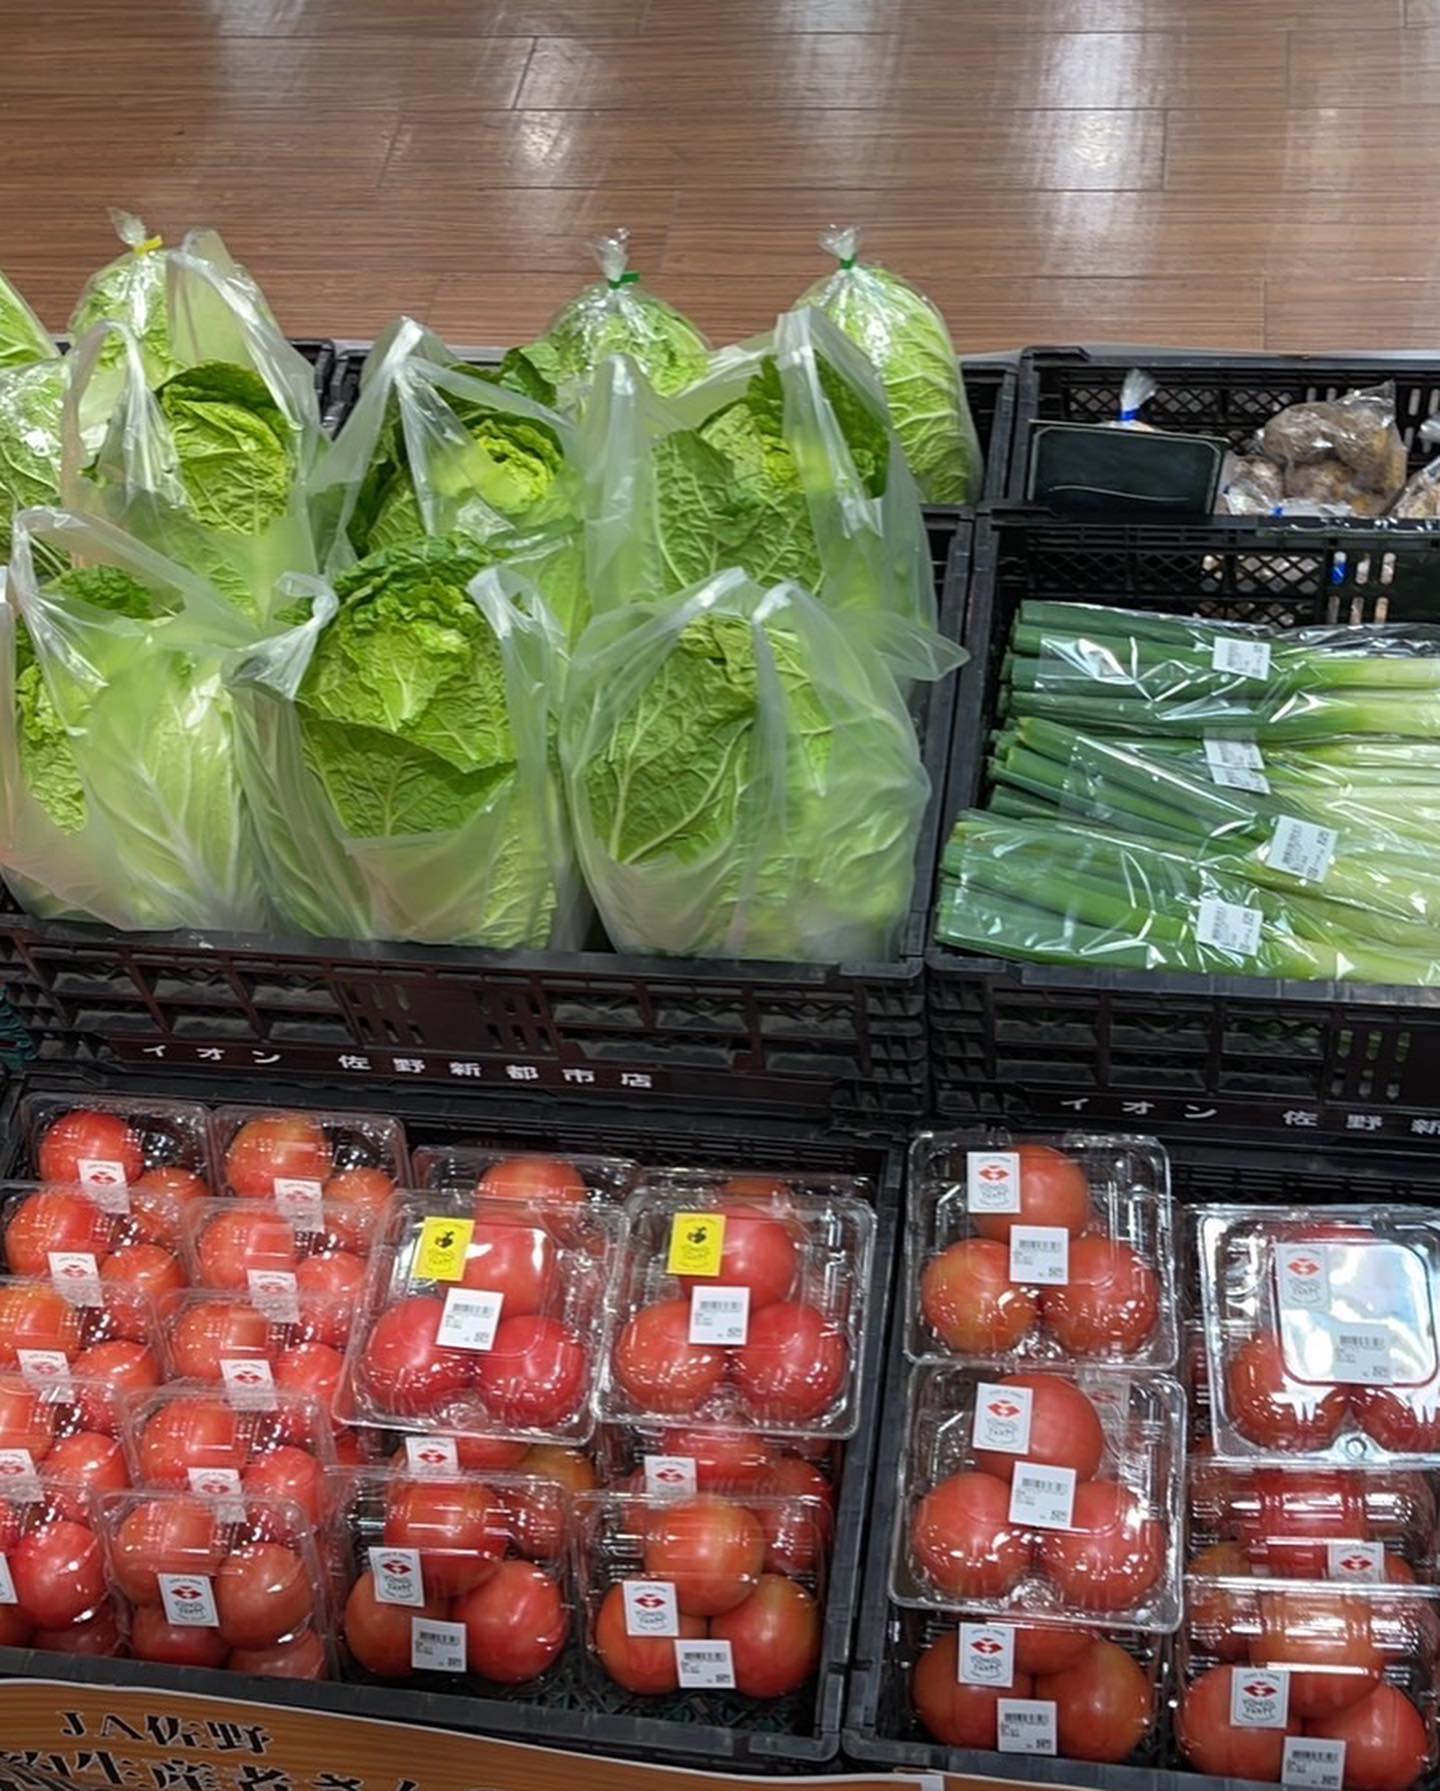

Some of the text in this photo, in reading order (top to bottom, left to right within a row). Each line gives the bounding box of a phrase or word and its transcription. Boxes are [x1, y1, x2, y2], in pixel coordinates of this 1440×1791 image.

[143, 1045, 652, 1088] イオン 佐野新都市店
[1061, 1098, 1217, 1119] イオン
[58, 1711, 272, 1754] JA佐野
